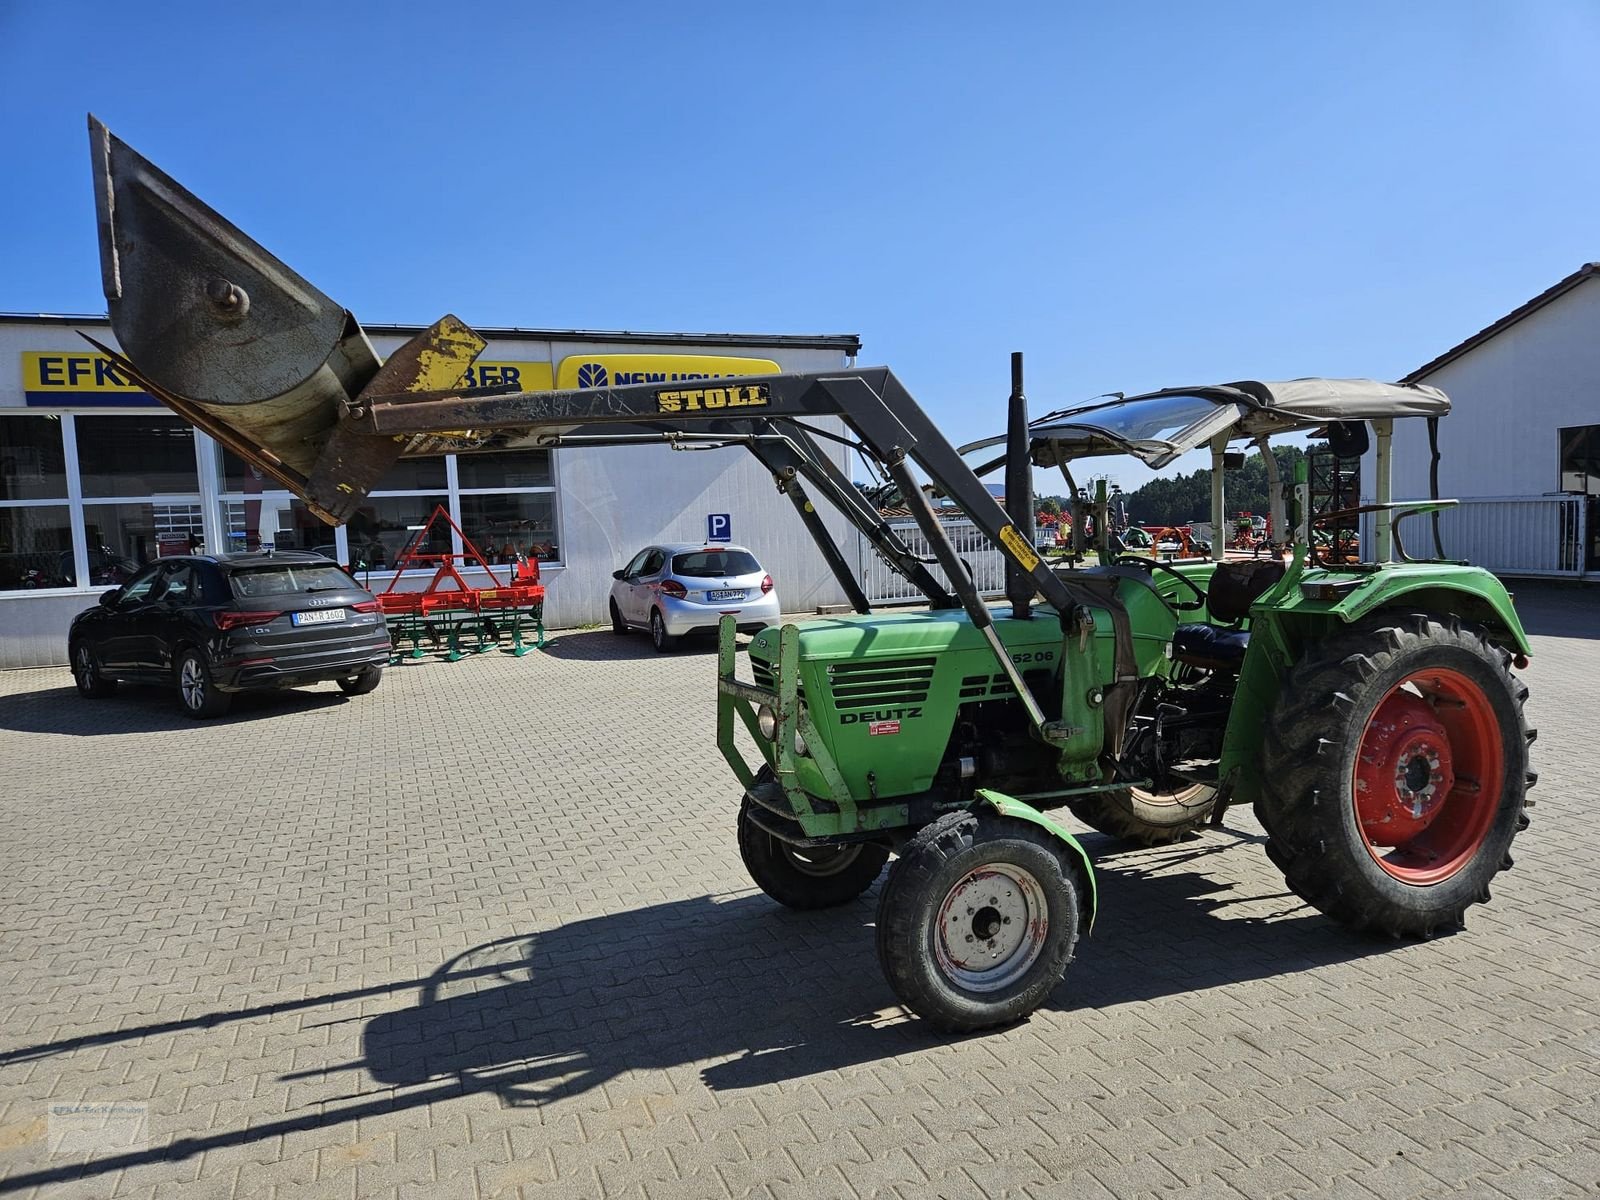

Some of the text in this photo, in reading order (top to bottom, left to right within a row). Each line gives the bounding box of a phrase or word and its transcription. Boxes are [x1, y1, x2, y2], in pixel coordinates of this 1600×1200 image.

[38, 357, 138, 386] EFK
[658, 385, 768, 413] STOLL
[713, 515, 726, 536] P
[840, 707, 922, 725] DEUTZ
